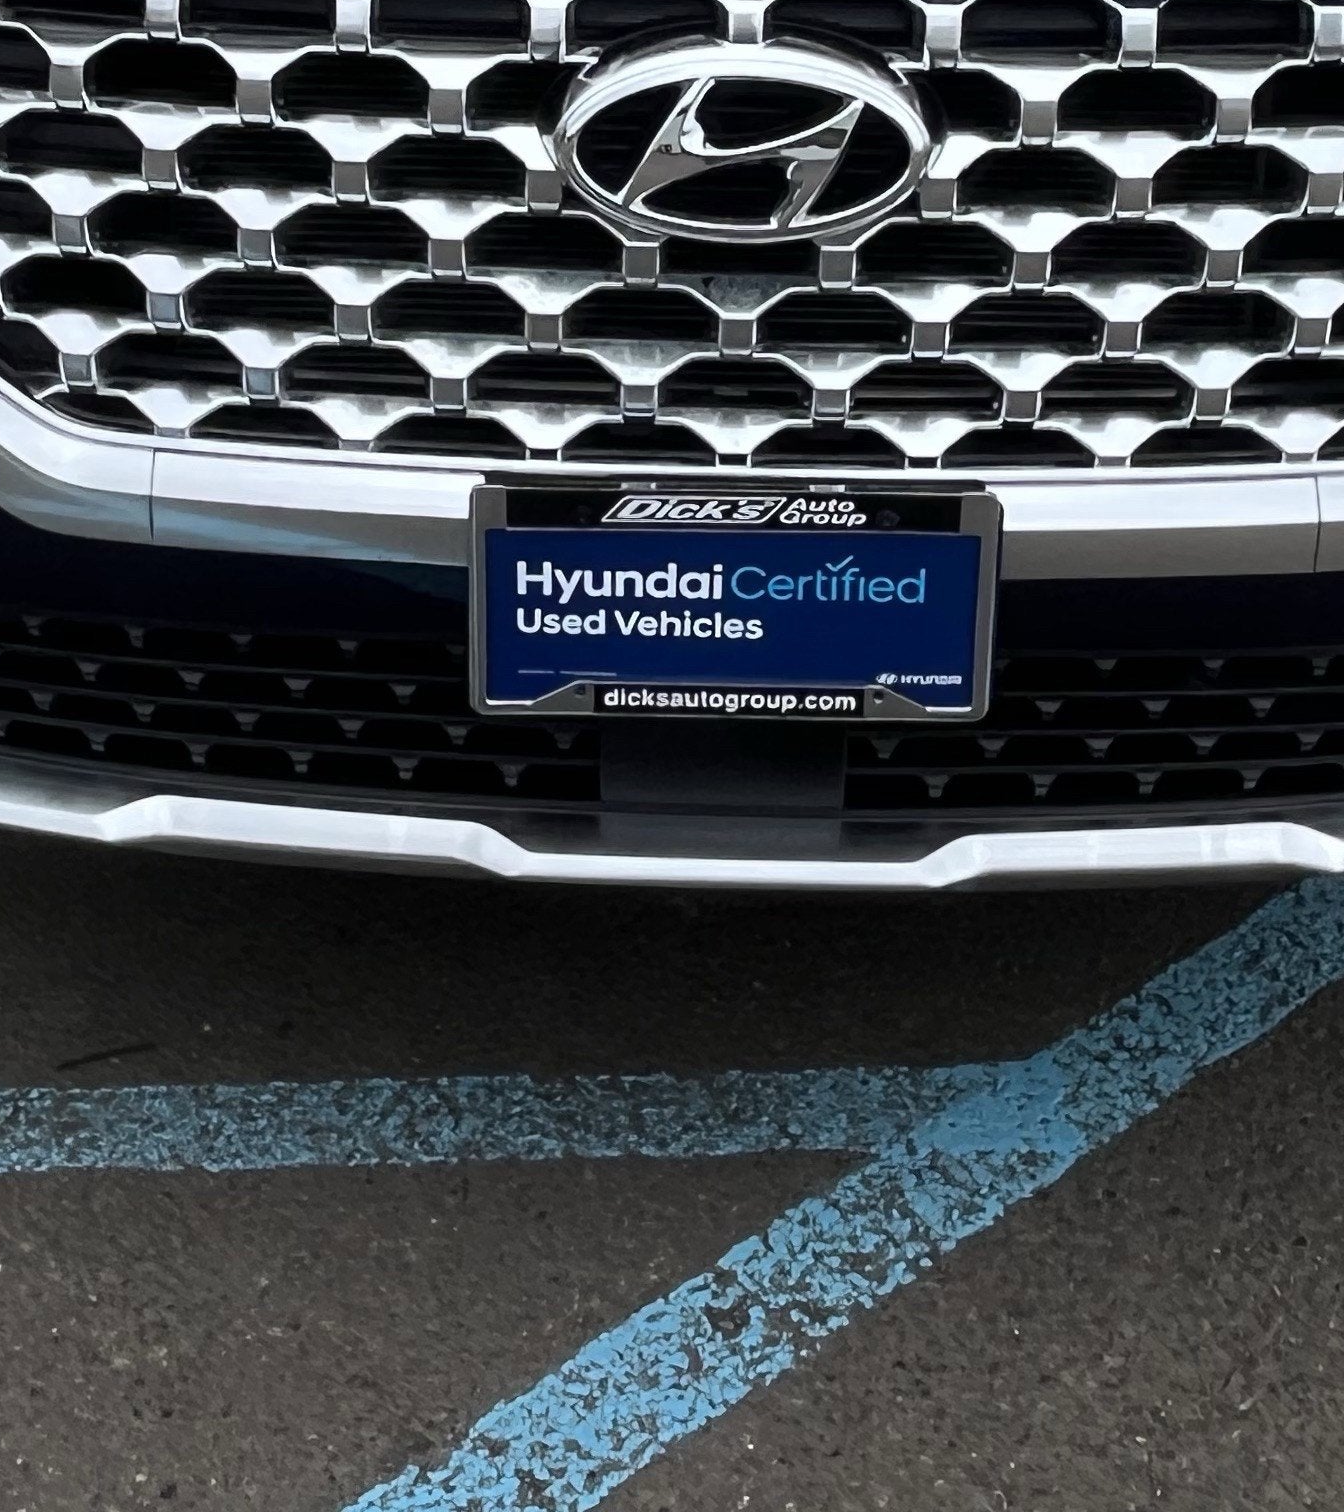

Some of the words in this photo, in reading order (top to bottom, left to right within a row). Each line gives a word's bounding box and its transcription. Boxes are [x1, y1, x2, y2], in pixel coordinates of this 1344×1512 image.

[787, 497, 855, 512] Auto
[779, 510, 867, 527] Group
[516, 560, 723, 605] Hyundai
[730, 561, 926, 604] Certified
[516, 607, 606, 635] Used
[614, 609, 764, 640] Vehicles
[603, 688, 857, 713] dicksautogroup.com
